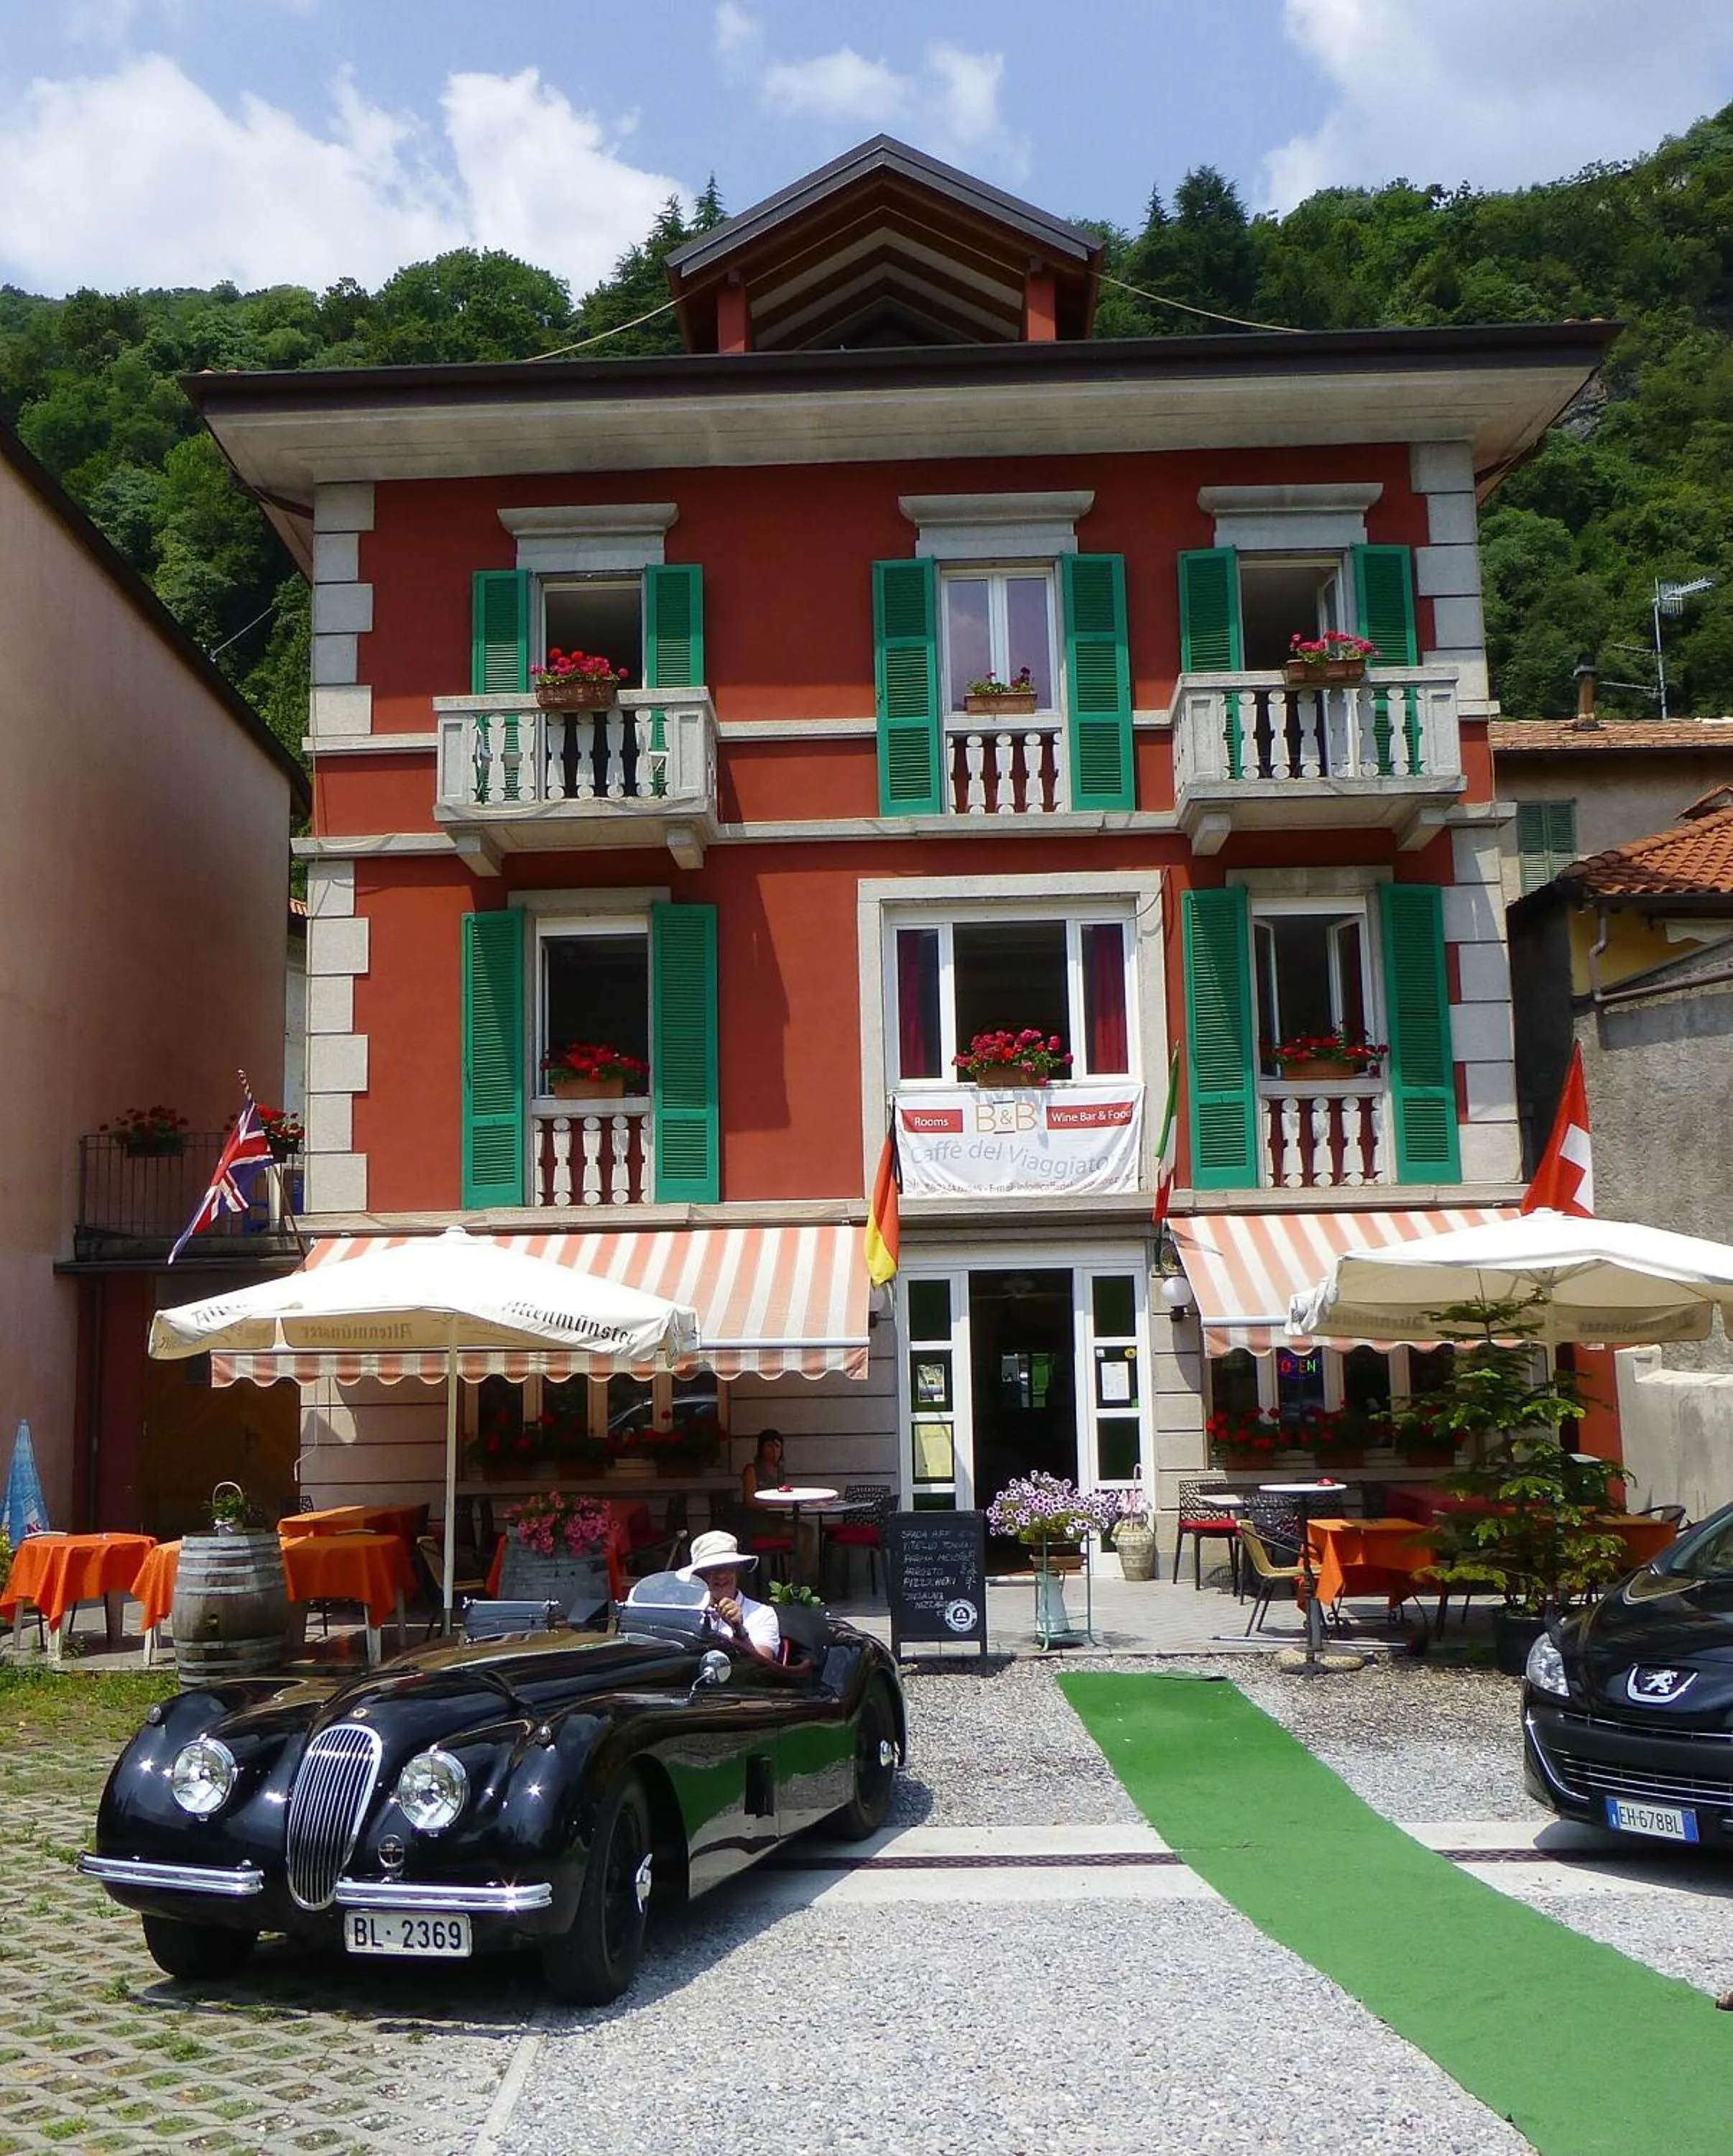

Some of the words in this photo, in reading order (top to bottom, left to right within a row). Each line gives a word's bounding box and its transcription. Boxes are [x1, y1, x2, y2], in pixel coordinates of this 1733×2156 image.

[914, 1117, 949, 1126] Rooms
[976, 1102, 1036, 1133] B&B
[1052, 1112, 1078, 1122] Wine
[1080, 1112, 1096, 1121] Bar
[1098, 1111, 1106, 1120] &
[969, 1140, 1002, 1161] del
[401, 1920, 461, 1950] 2369
